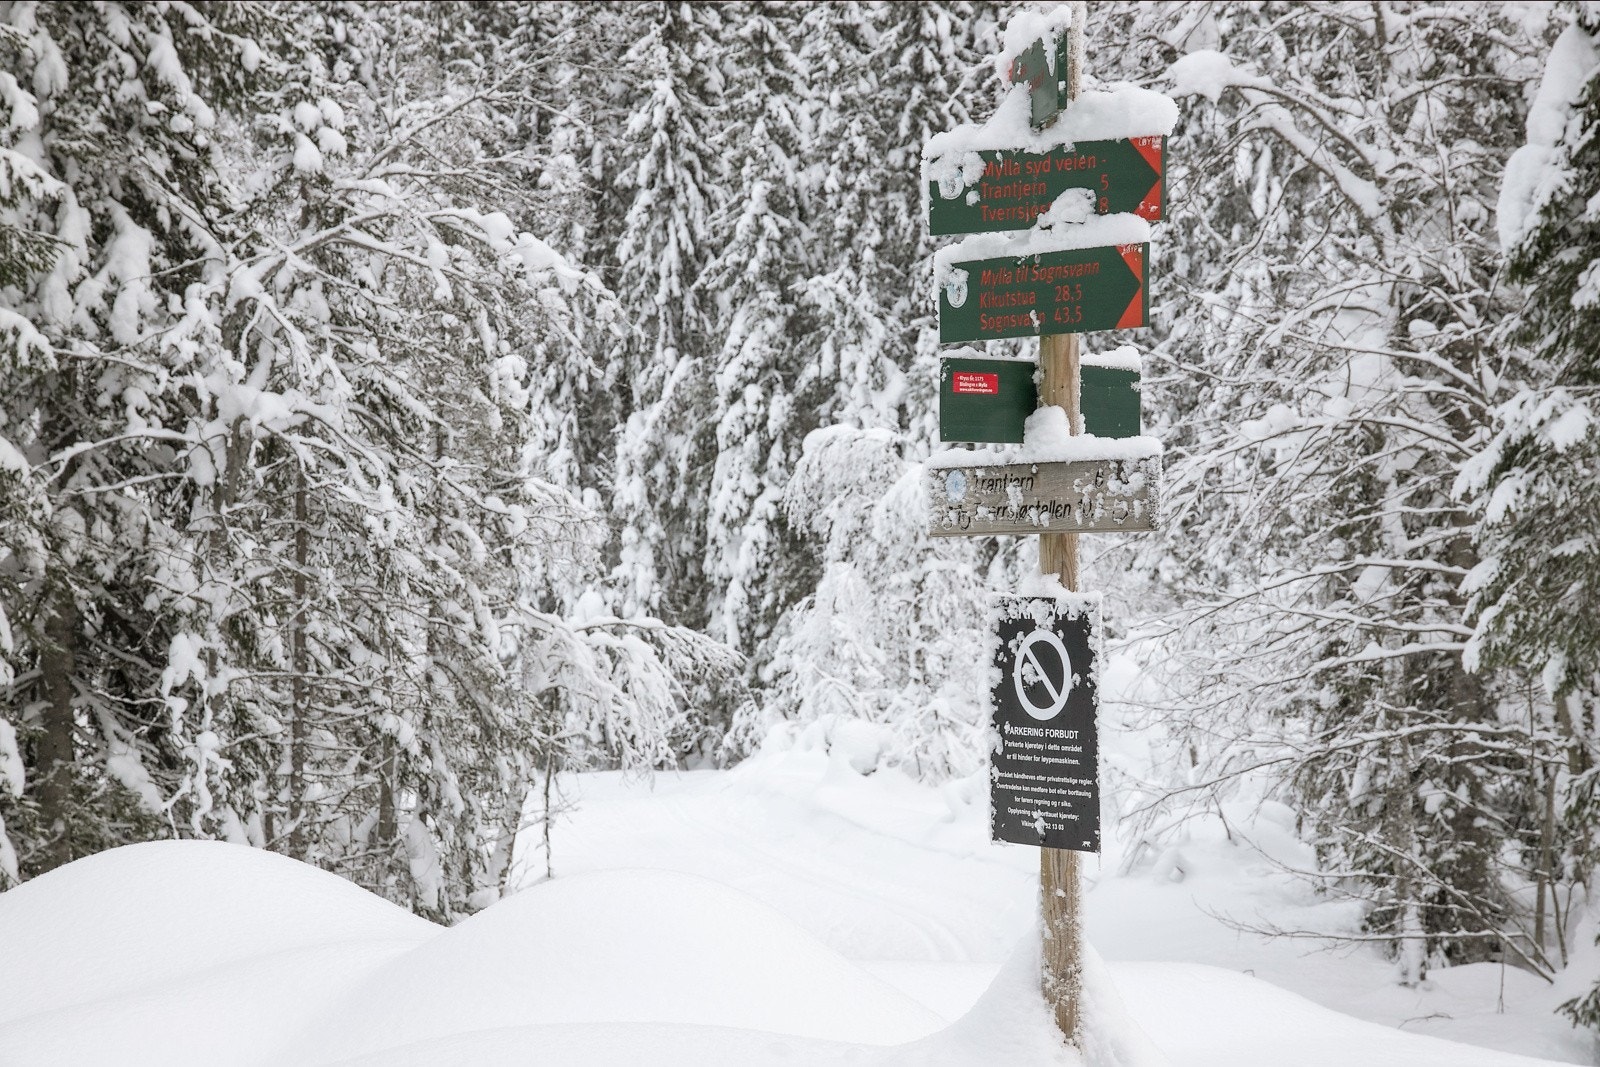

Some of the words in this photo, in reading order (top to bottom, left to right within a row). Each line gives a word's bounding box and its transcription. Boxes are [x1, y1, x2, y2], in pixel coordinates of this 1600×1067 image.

[984, 158, 1020, 180] Mylla
[1025, 154, 1051, 177] syd
[1056, 152, 1096, 171] veien
[981, 180, 1047, 201] Trantjern
[1100, 173, 1109, 191] 5
[1100, 196, 1109, 213] 8
[981, 266, 1013, 287] Mylla
[1015, 264, 1028, 283] til
[1031, 261, 1100, 284] Sognsvann
[980, 291, 1036, 309] Kikutstua
[980, 310, 1046, 332] Sognsvan
[1005, 726, 1044, 737] ARKERING
[1045, 729, 1079, 739] FORBUDT
[1004, 740, 1024, 748] Parkerte
